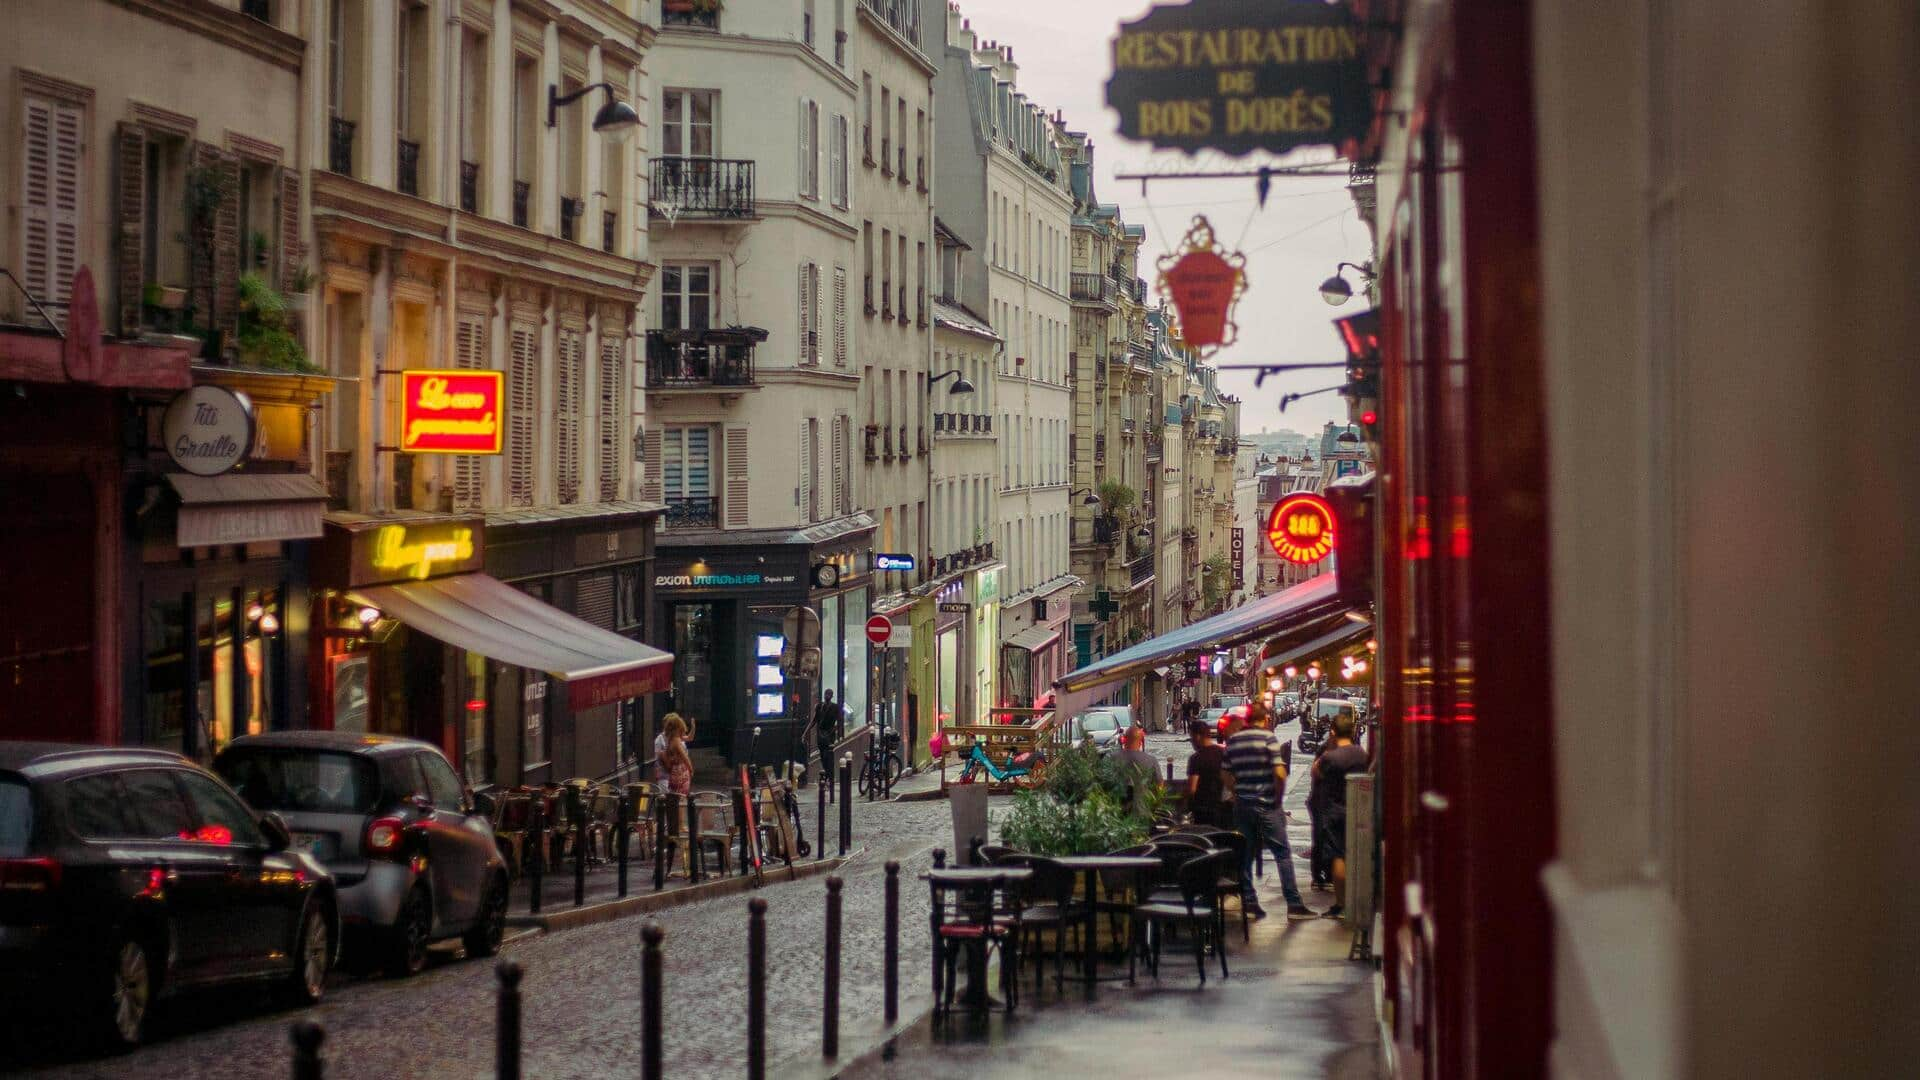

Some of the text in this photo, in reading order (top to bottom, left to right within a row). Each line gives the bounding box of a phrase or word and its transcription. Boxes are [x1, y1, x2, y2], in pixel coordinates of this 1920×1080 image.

[1117, 28, 1356, 66] RESTAURATION
[1218, 71, 1255, 94] DE
[1140, 89, 1332, 135] BOIS DORÉS
[192, 402, 219, 426] Titi
[175, 434, 238, 458] Graille
[1232, 529, 1242, 580] HOTEL
